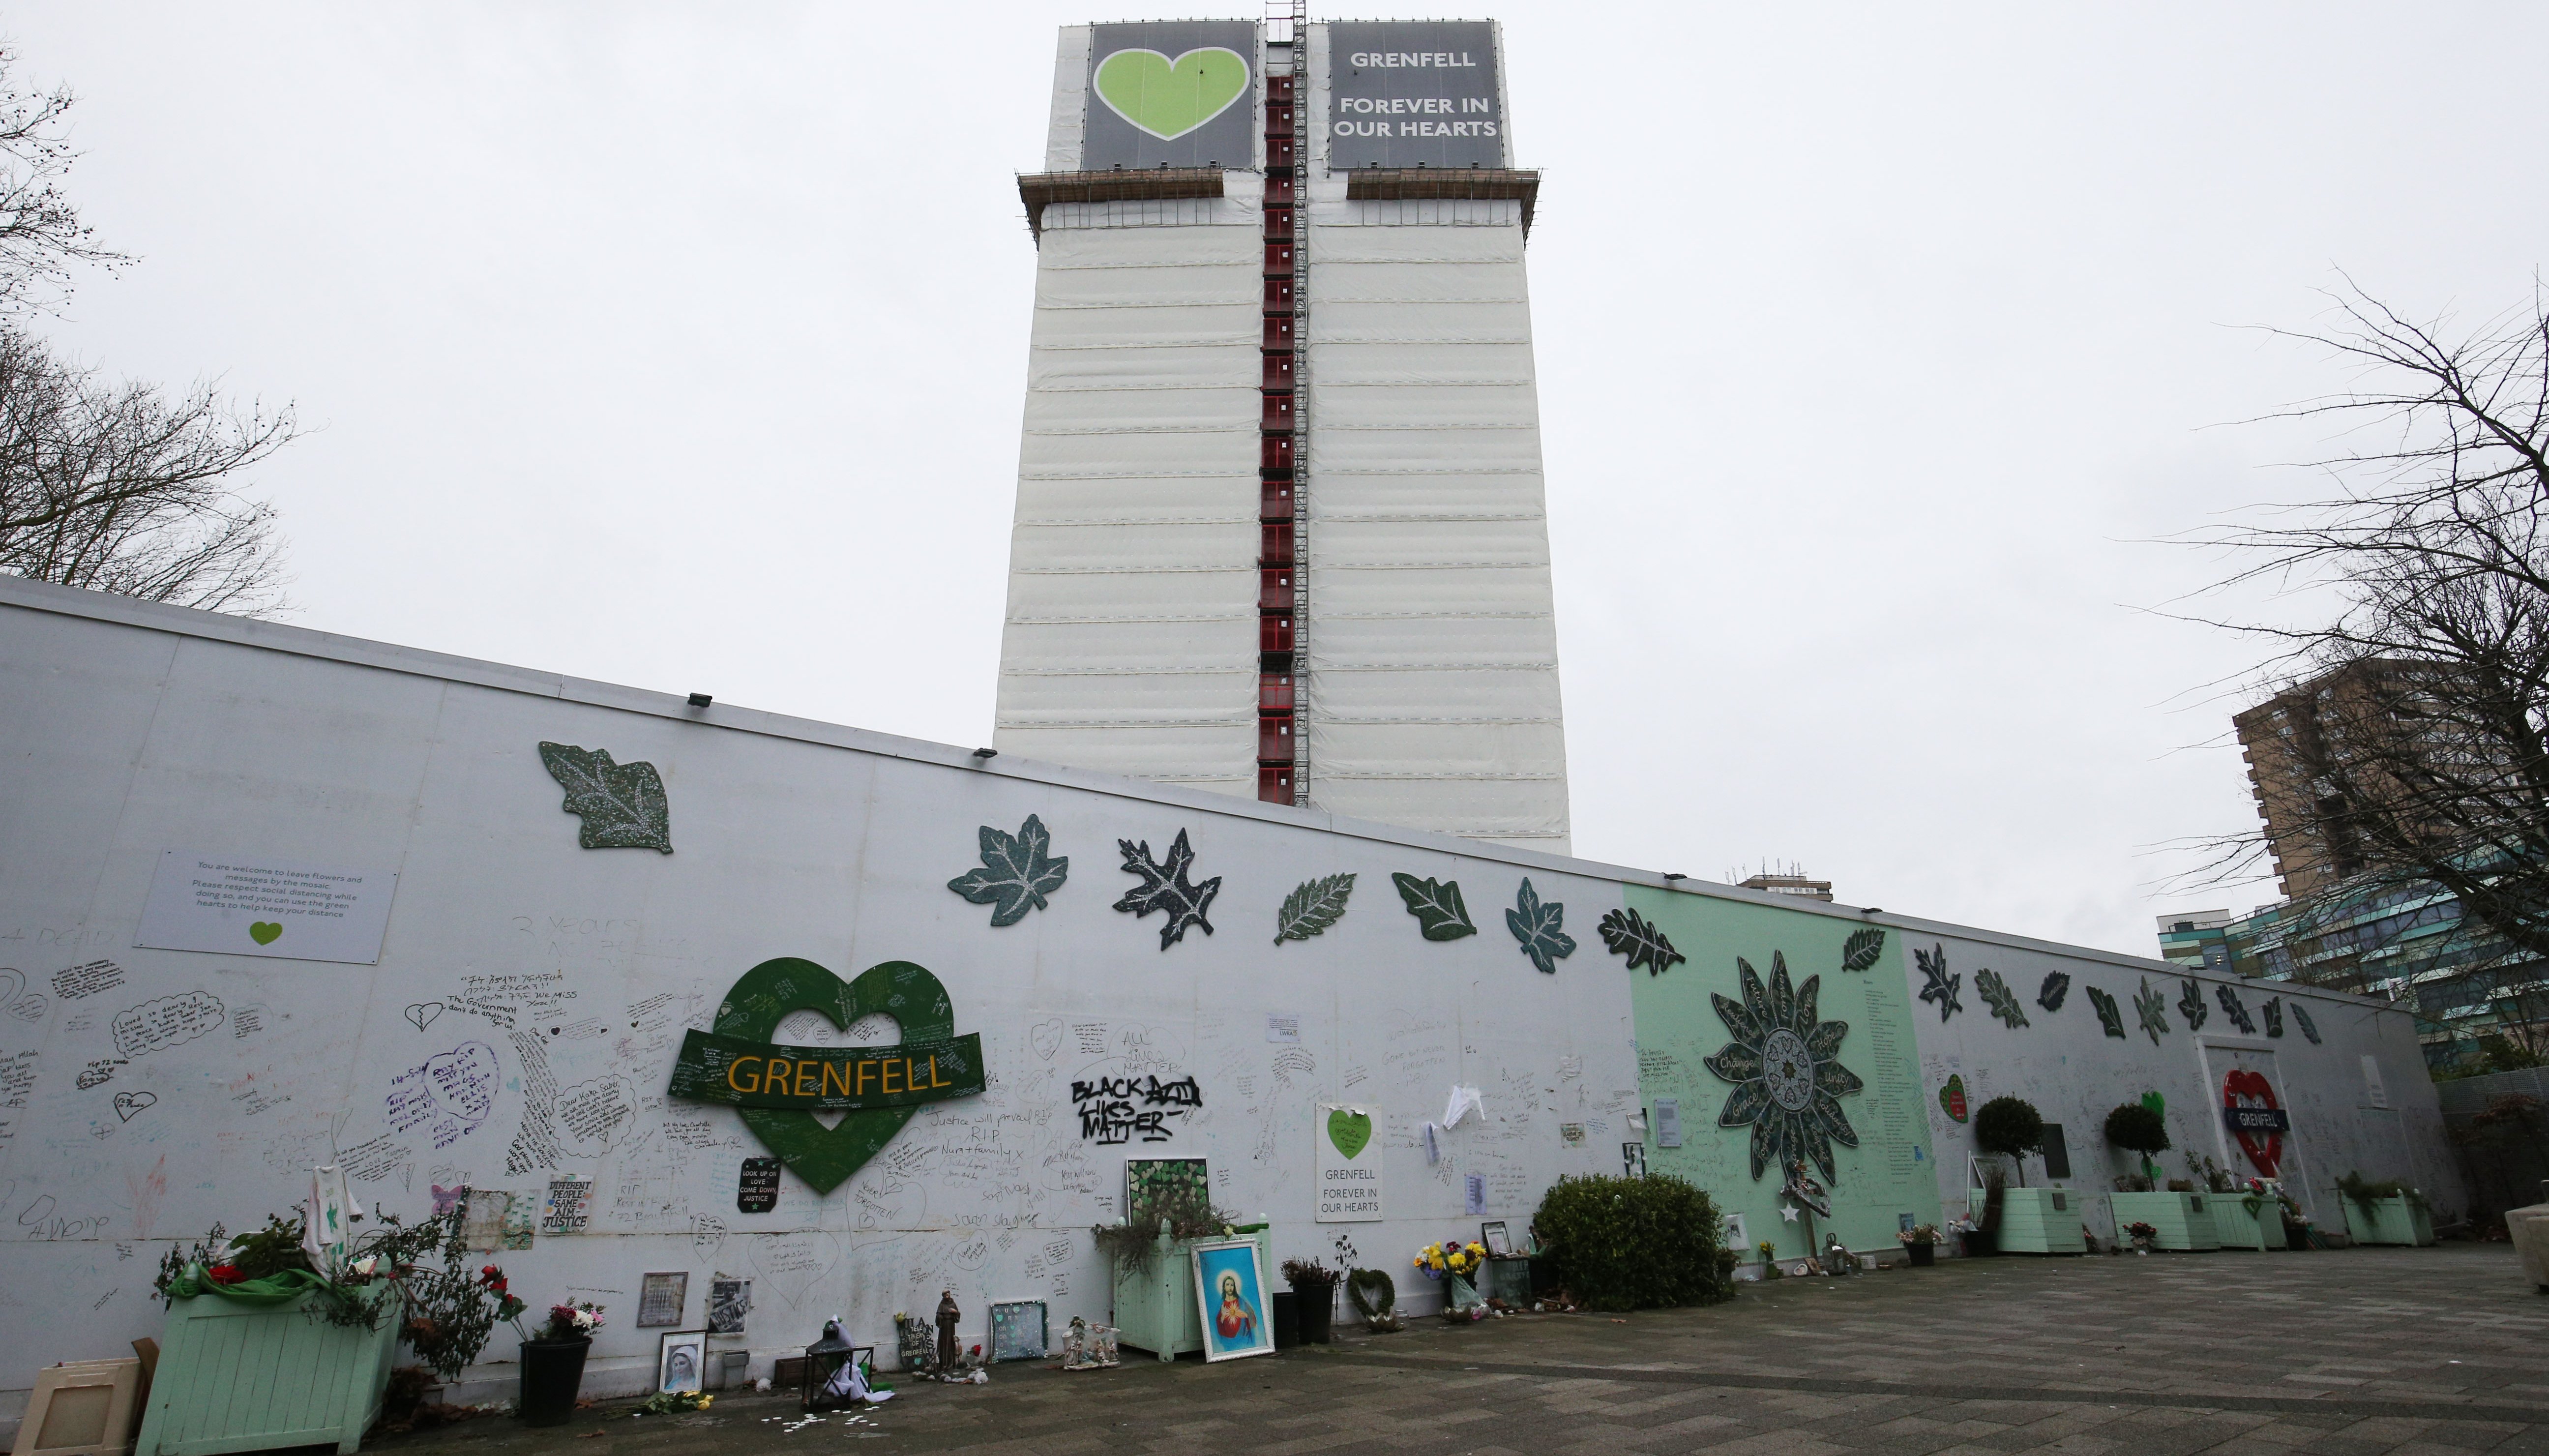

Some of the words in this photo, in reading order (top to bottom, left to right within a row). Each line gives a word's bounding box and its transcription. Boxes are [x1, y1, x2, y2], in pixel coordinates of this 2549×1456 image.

[1351, 52, 1476, 67] GRENFELL
[1341, 98, 1455, 114] FOREVER
[1462, 98, 1488, 113] IN
[1334, 121, 1393, 137] OUR
[1400, 121, 1497, 137] HEARTS
[226, 875, 267, 884] messages
[313, 873, 344, 881] flowers
[193, 880, 222, 888] Please
[290, 889, 331, 900] distancing
[196, 890, 220, 899] doing
[264, 905, 284, 914] keep
[308, 909, 343, 918] distance
[1747, 977, 1769, 1018] Future
[1777, 967, 1789, 1019] Forever
[2045, 978, 2065, 1003] Humanity
[467, 998, 517, 1014] Government
[1800, 991, 1812, 1025] Love
[119, 1016, 141, 1029] Loved
[162, 1001, 186, 1012] dearly
[1816, 1032, 1836, 1050] Hope
[1403, 1057, 1445, 1072] FORGOTTEN
[1720, 1057, 1754, 1071] Change
[728, 1055, 951, 1097] GRENFELL
[1825, 1071, 1849, 1087] Unity
[1071, 1076, 1144, 1103] BLACK
[560, 1098, 577, 1111] Dear
[1733, 1092, 1758, 1116] Grace
[925, 1110, 969, 1127] Justice
[975, 1114, 992, 1123] will
[998, 1109, 1031, 1127] prevail
[1083, 1111, 1173, 1140] MATTER
[2239, 1112, 2278, 1127] GRENFELL
[972, 1126, 1000, 1143] RIP
[975, 1143, 1010, 1164] family
[1326, 1170, 1375, 1179] GRENFELL
[553, 1190, 585, 1199] PEOPLE:
[861, 1180, 878, 1198] NEVER
[1324, 1189, 1365, 1198] FOREVER
[1368, 1188, 1377, 1197] IN
[554, 1199, 577, 1208] SAME
[855, 1189, 904, 1220] FORGOTTEN
[1321, 1203, 1341, 1212] OUR
[1345, 1202, 1378, 1212] HEARTS
[543, 1216, 588, 1227] JUSTICE
[902, 1348, 928, 1357] GRENFELL
